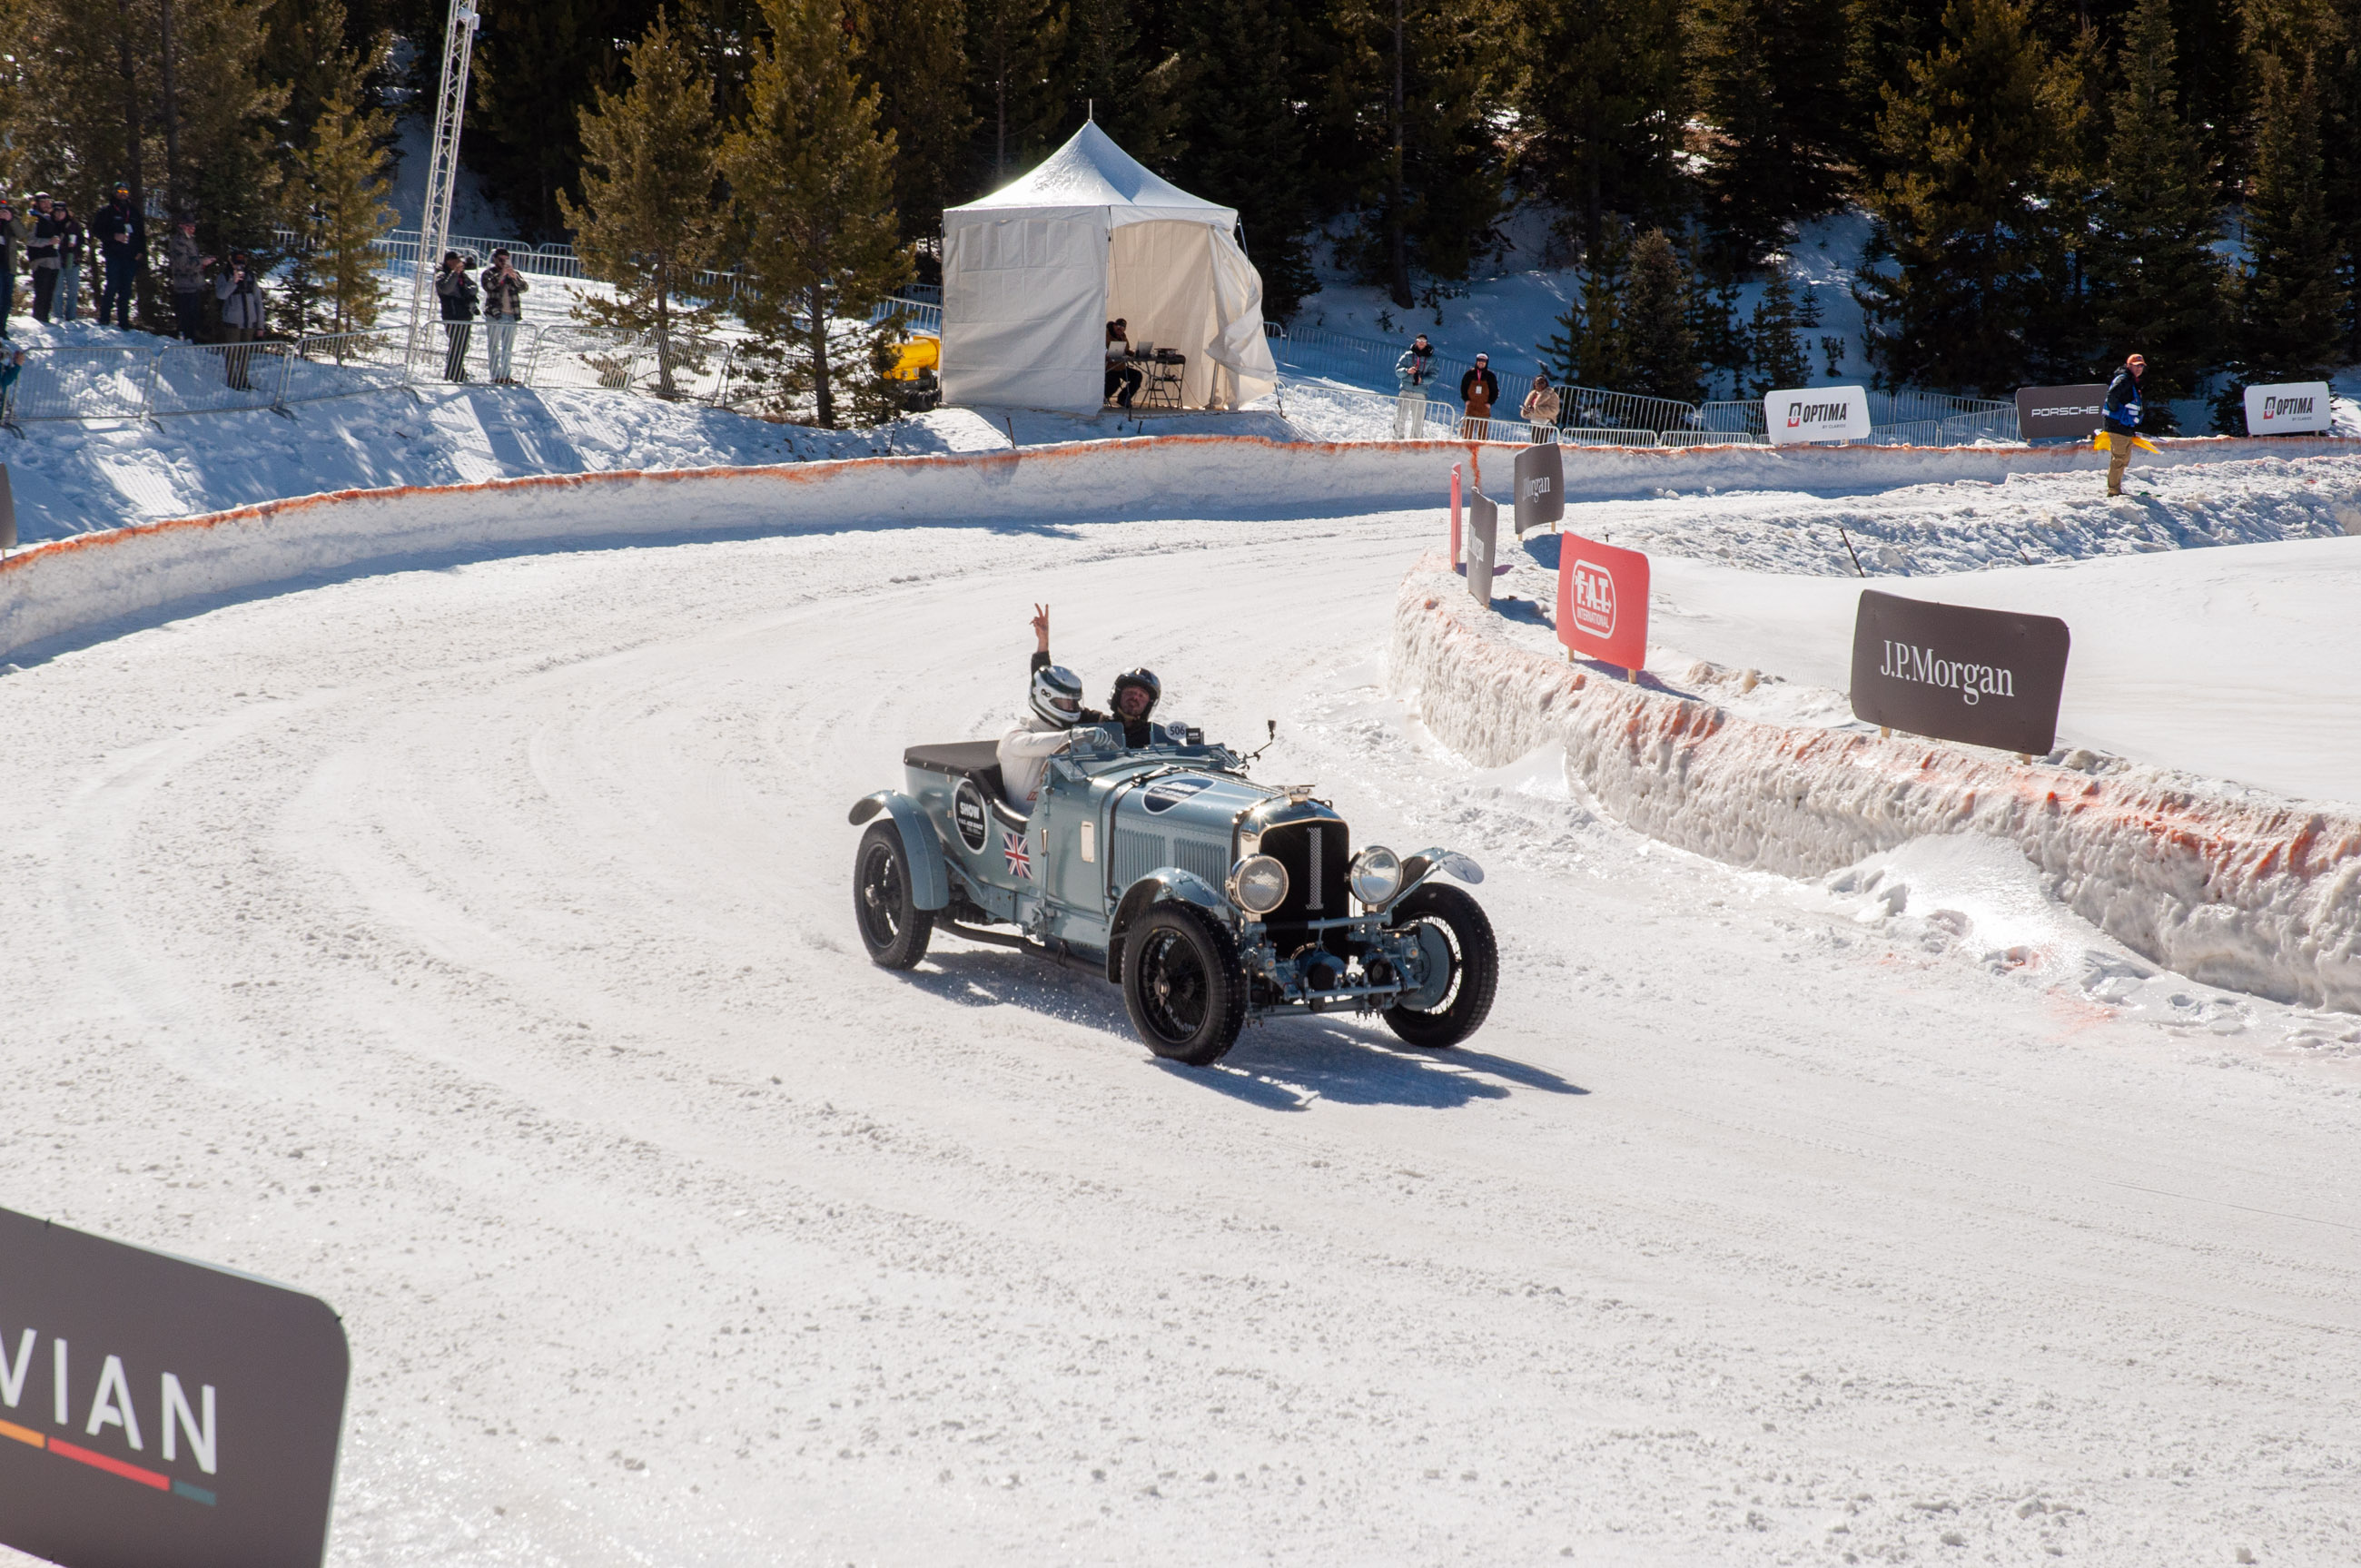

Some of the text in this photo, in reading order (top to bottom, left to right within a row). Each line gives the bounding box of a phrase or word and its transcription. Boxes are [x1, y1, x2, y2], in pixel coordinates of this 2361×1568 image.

[1803, 403, 1847, 423] OPTIMA
[2031, 405, 2100, 418] PORSCHE
[2277, 397, 2314, 415] OPTIMA
[1576, 606, 1610, 629] INTERNATIONAL
[1880, 639, 2015, 705] J.P.Morgan
[1170, 725, 1185, 736] 506
